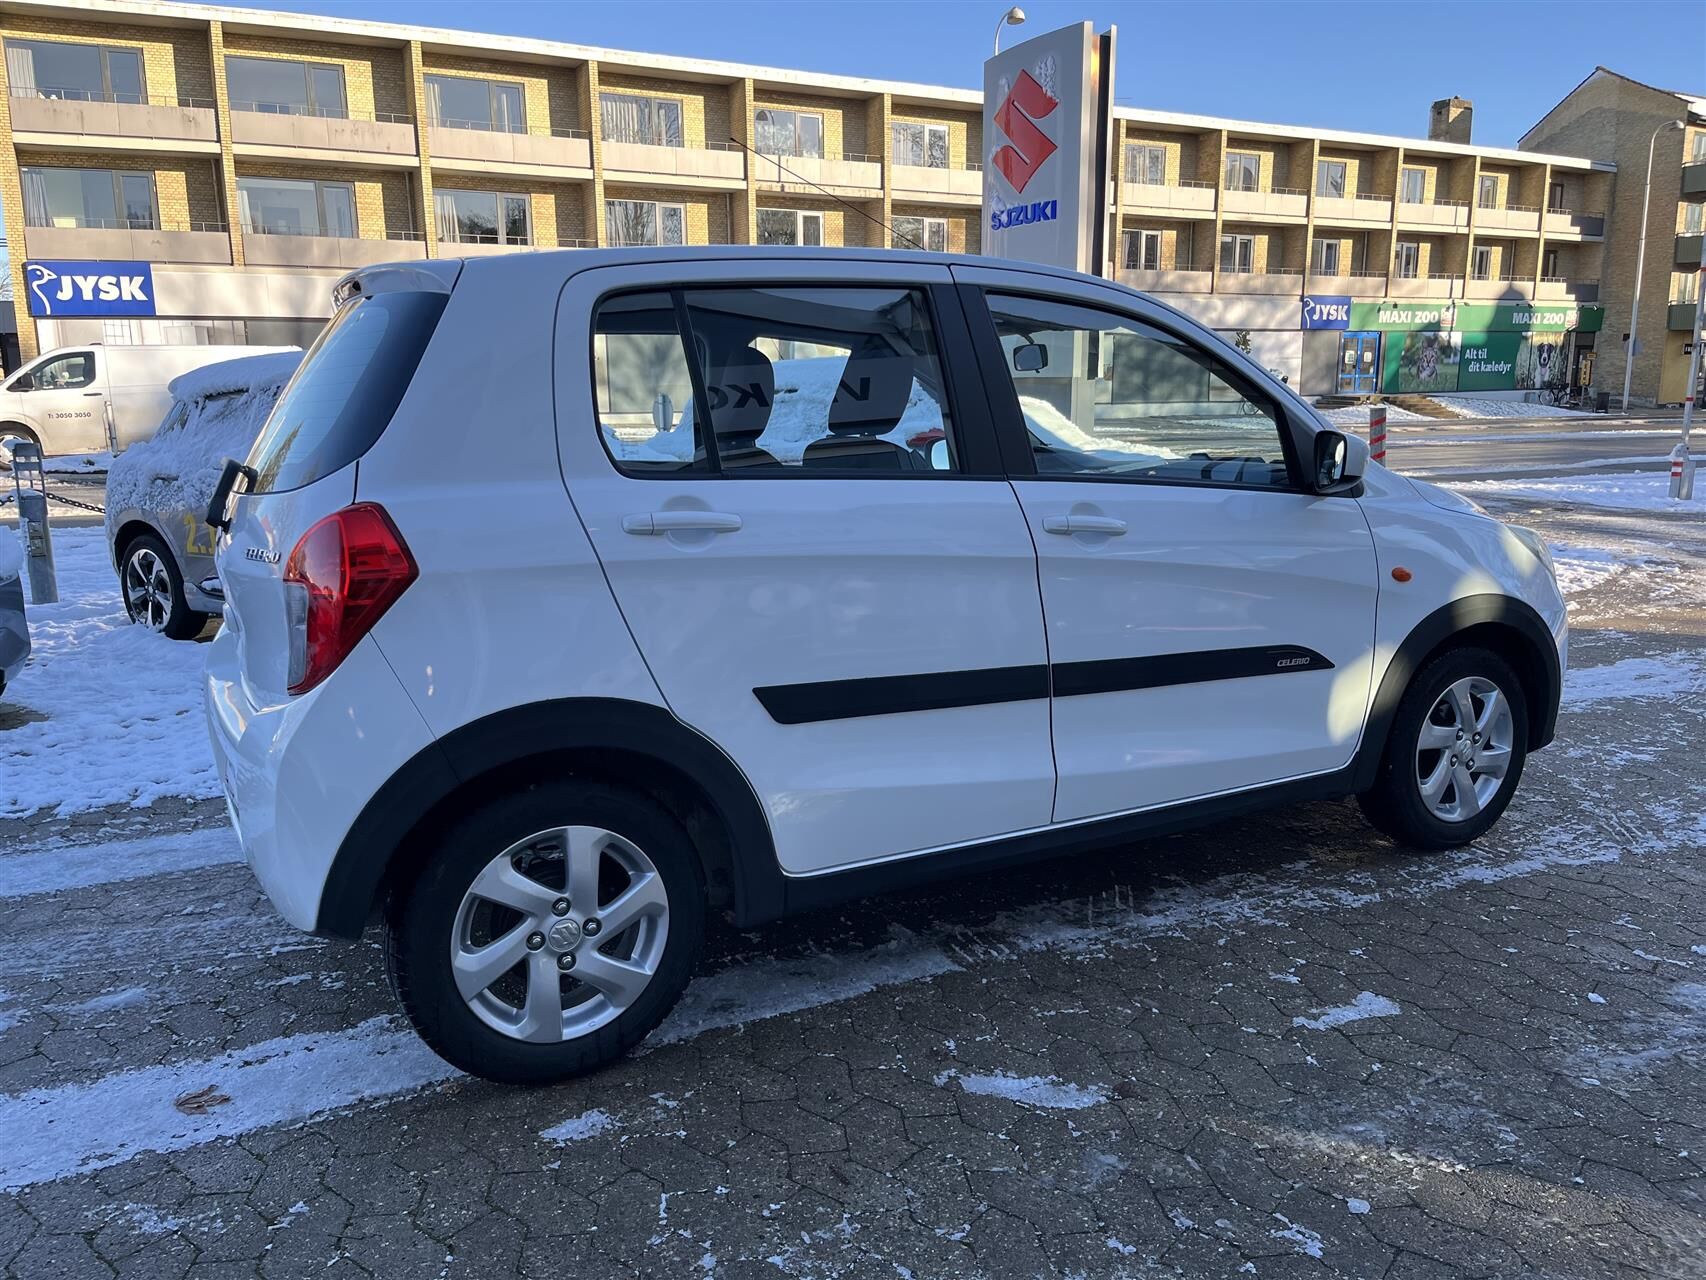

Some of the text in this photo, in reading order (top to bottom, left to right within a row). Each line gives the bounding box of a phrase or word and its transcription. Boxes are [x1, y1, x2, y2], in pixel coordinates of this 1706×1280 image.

[991, 200, 1057, 230] SUZUKI
[56, 275, 149, 301] JYSK
[1312, 304, 1349, 321] JYSK
[1379, 311, 1412, 324] MAXI
[1413, 311, 1439, 324] ZOO
[1512, 312, 1541, 325] MAXI
[1542, 312, 1565, 325] ZOO
[1464, 348, 1488, 360] Alt til
[1468, 360, 1512, 374] dit kæledyr
[1277, 657, 1310, 667] CELERIO
